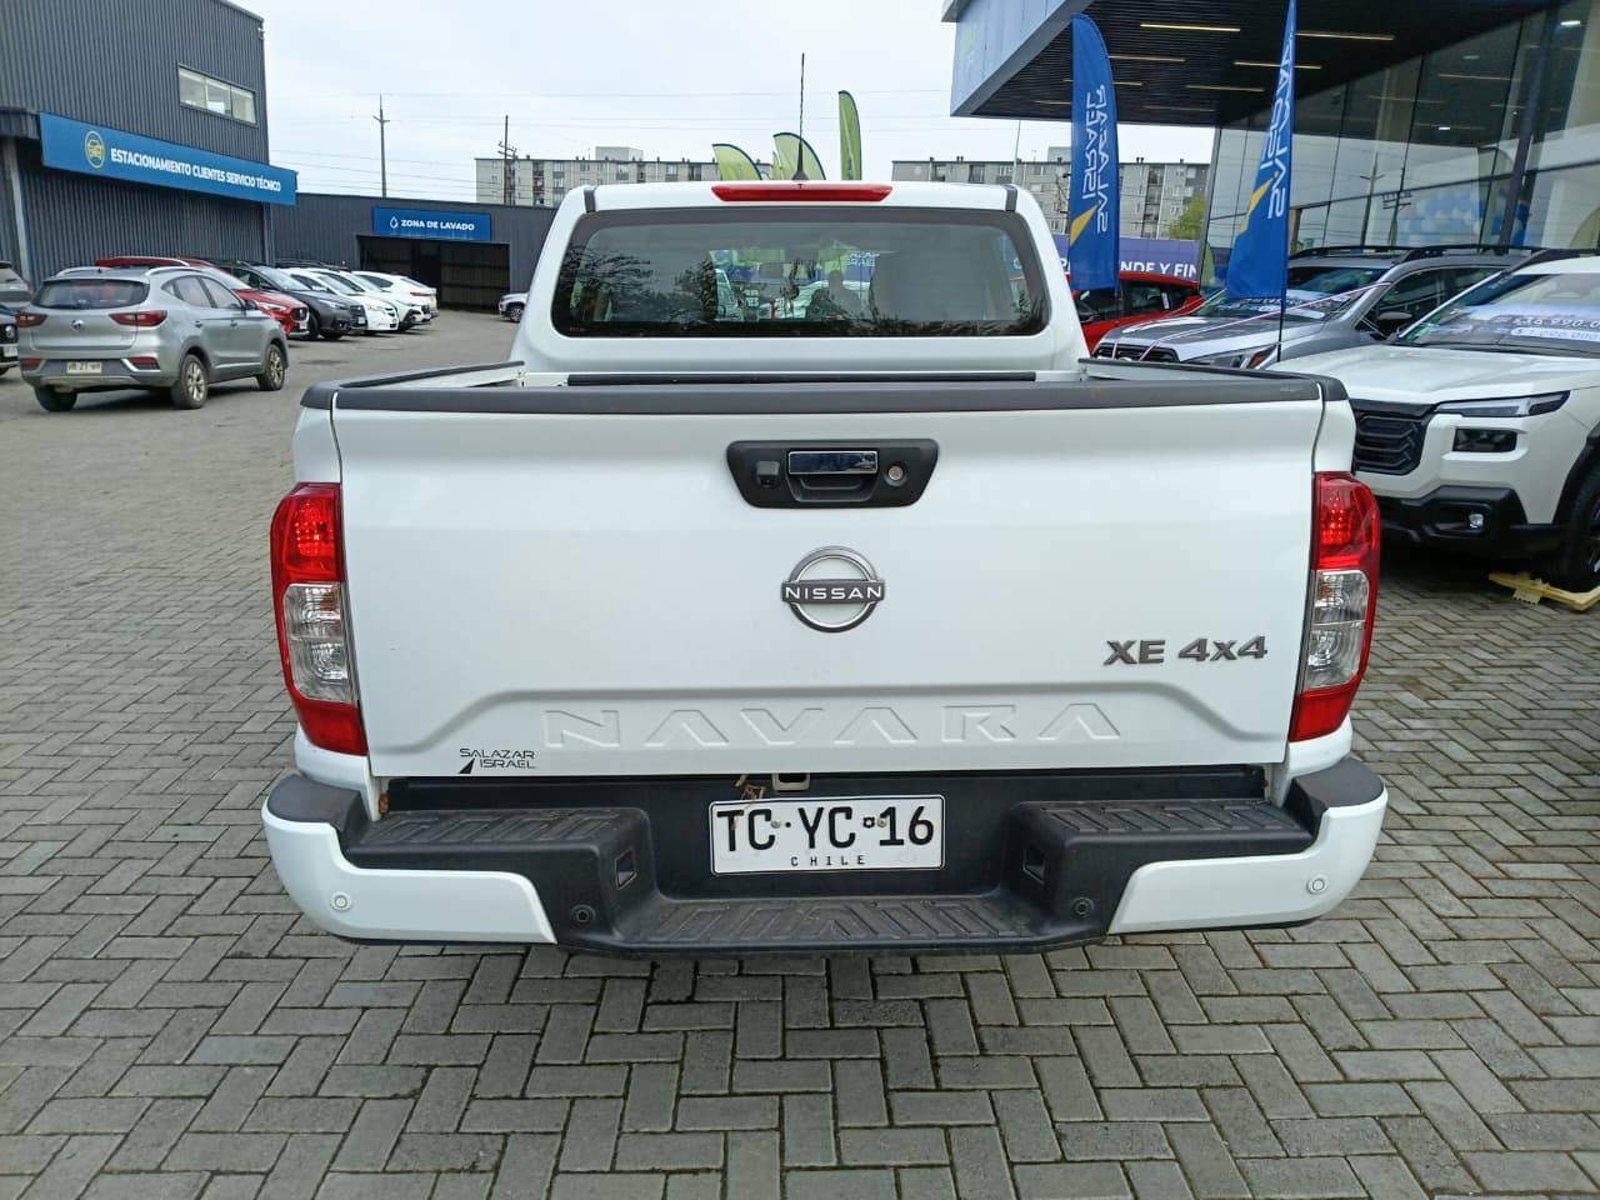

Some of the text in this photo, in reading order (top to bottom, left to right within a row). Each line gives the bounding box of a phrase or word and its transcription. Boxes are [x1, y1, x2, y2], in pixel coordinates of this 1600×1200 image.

[110, 148, 281, 192] ESTACIONAMIENTO CLIENTES SERVICIO TÉCNICO
[400, 219, 475, 231] ZONA DE LAVADO
[1160, 263, 1171, 275] Y
[785, 586, 881, 600] NISSAN
[1103, 635, 1268, 666] XE 4x4
[544, 702, 1121, 748] NAVARA
[459, 748, 535, 760] SALAZAR
[479, 758, 536, 769] ISRAEL
[790, 854, 867, 867] CHILE
